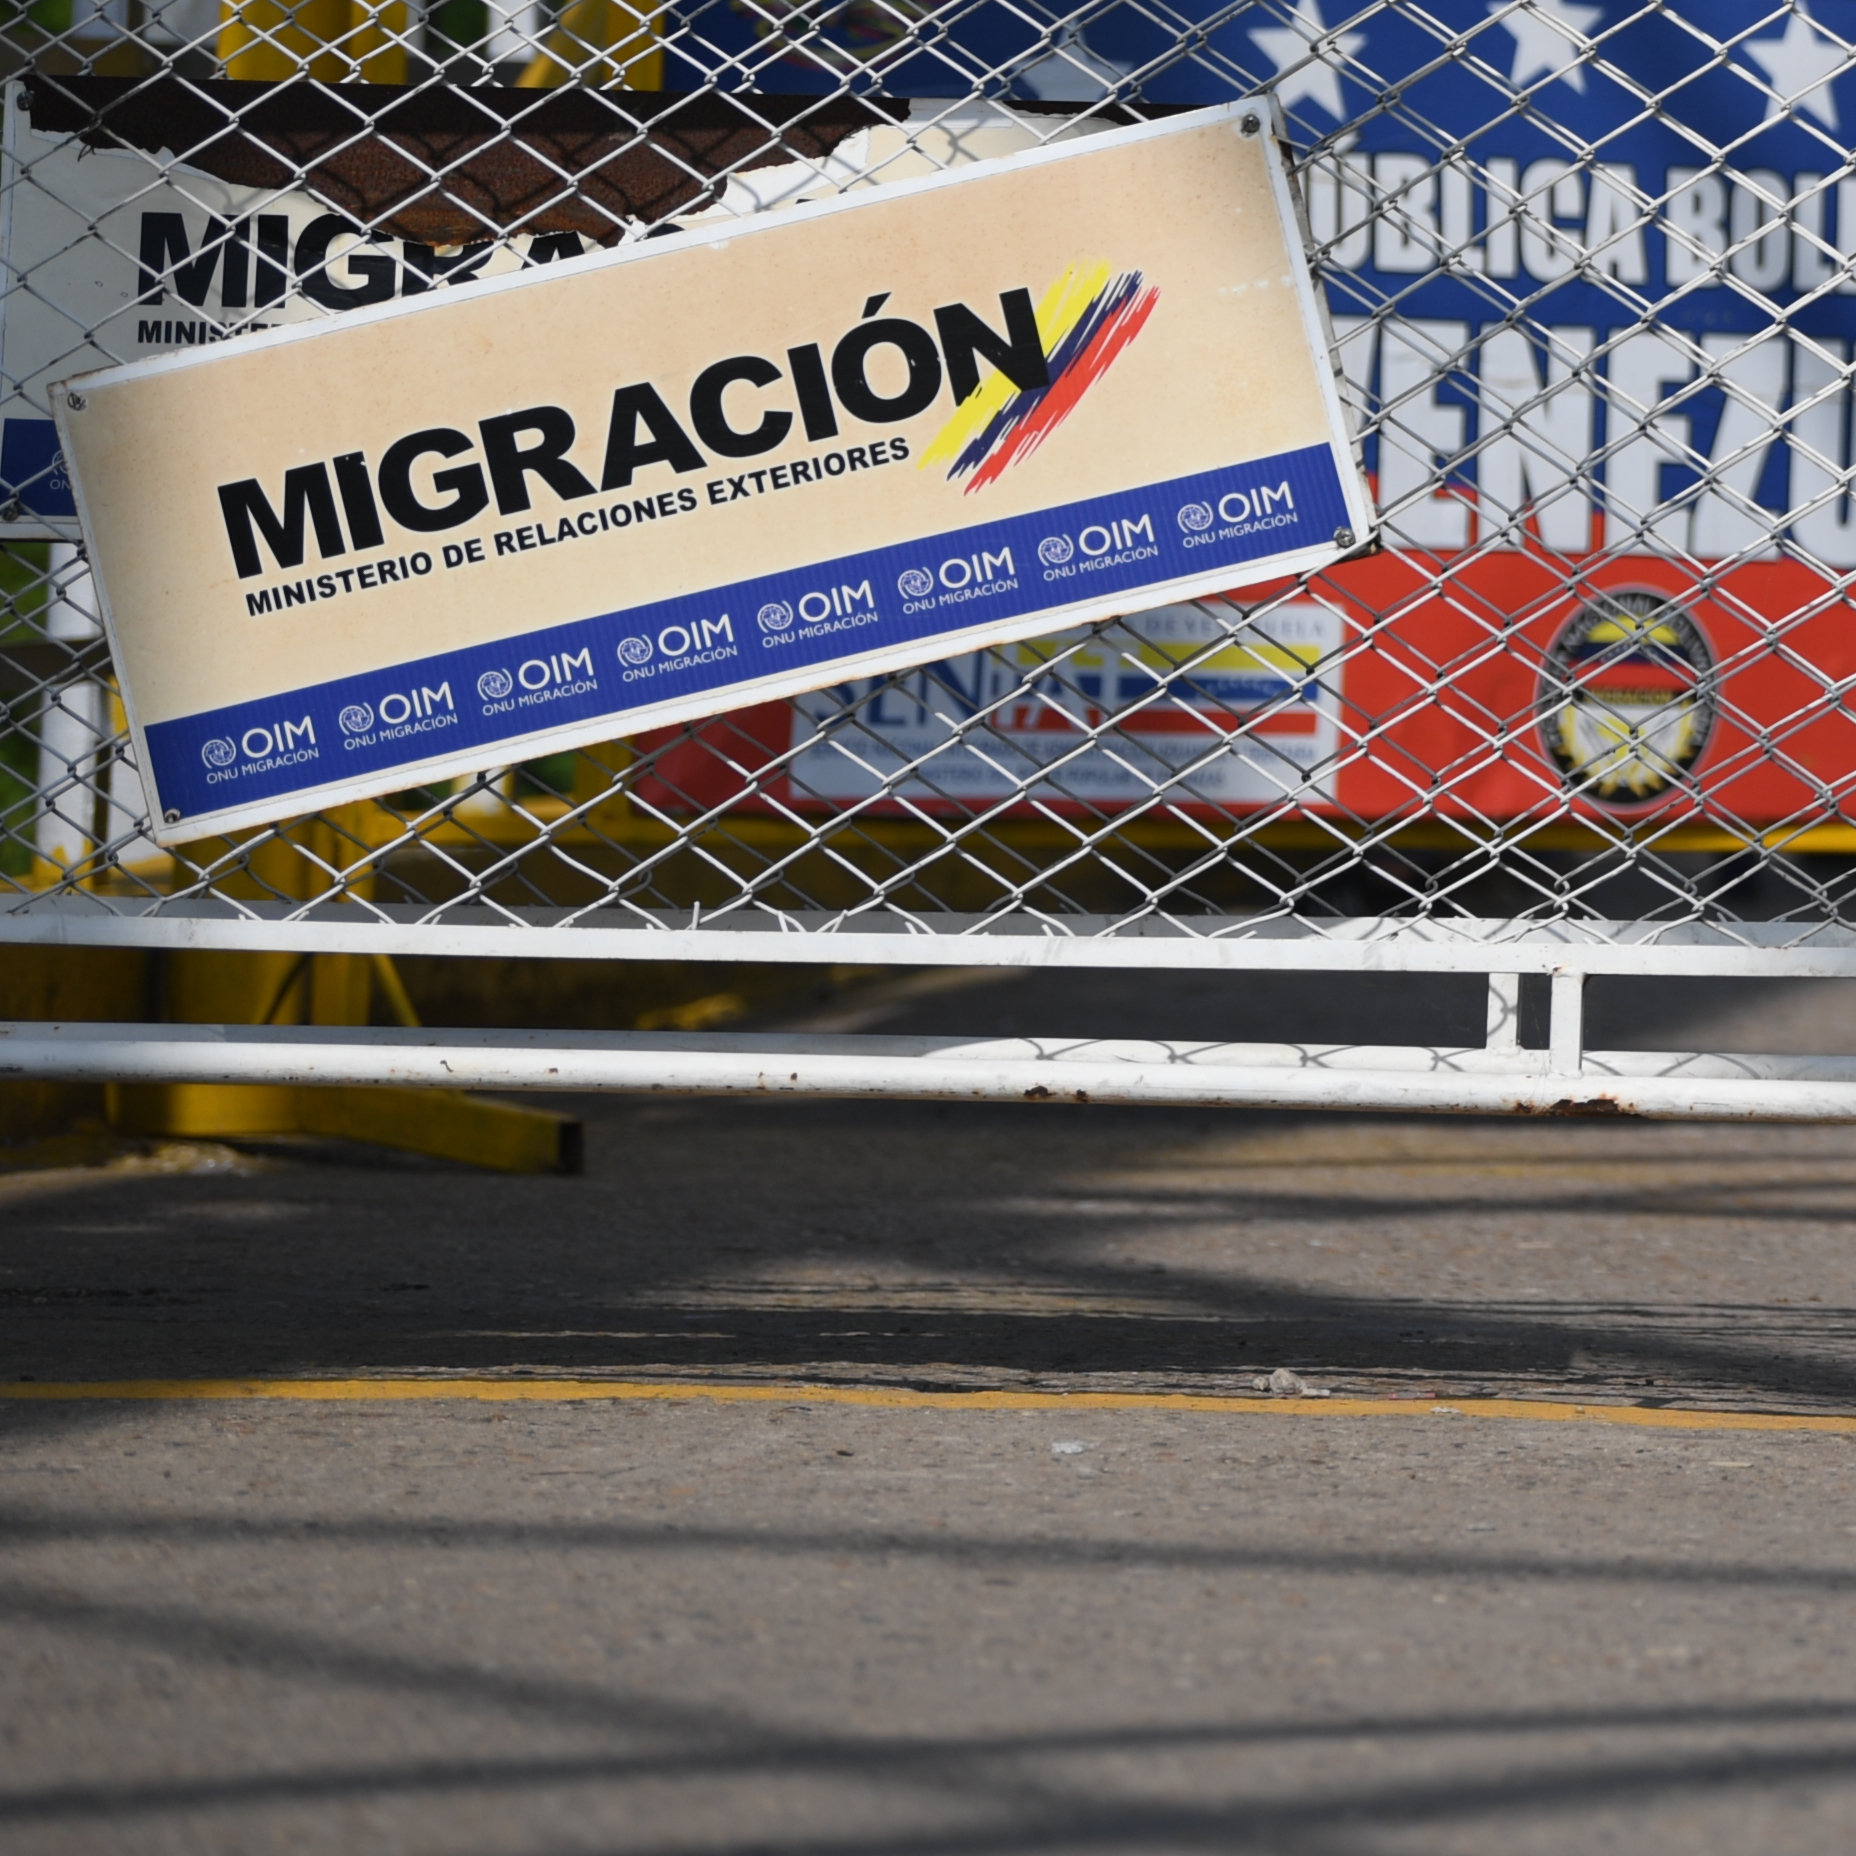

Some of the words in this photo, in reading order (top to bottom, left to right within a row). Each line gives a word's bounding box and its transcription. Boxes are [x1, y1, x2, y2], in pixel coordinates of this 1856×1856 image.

[217, 287, 1050, 580] MIGRACIÓN
[1218, 481, 1294, 523] OIM
[245, 551, 433, 617] MINISTERIO
[442, 538, 486, 569] DE
[494, 487, 698, 556] RELACIONES
[706, 437, 910, 505] EXTERIORES
[1078, 514, 1154, 556] OIM
[1183, 532, 1216, 548] ONU
[1218, 512, 1298, 540] MIGRACIÓN
[939, 546, 1015, 588] OIM
[1043, 565, 1076, 582] ONU
[1079, 545, 1159, 574] MIGRACIÓN
[798, 580, 874, 622] OIM
[903, 598, 935, 614] ONU
[939, 578, 1019, 606] MIGRACIÓN
[658, 614, 734, 656] OIM
[762, 631, 795, 648] ONU
[798, 611, 878, 640] MIGRACIÓN
[518, 647, 594, 690] OIM
[622, 665, 655, 682] ONU
[658, 645, 738, 674] MIGRACIÓN
[379, 681, 454, 724] OIM
[482, 699, 515, 716] ONU
[518, 679, 598, 708] MIGRACIÓN
[242, 715, 316, 758] OIM
[344, 734, 376, 750] ONU
[380, 713, 459, 742] MIGRACIÓN
[206, 767, 238, 784] ONU
[241, 747, 320, 775] MIGRACIÓN
